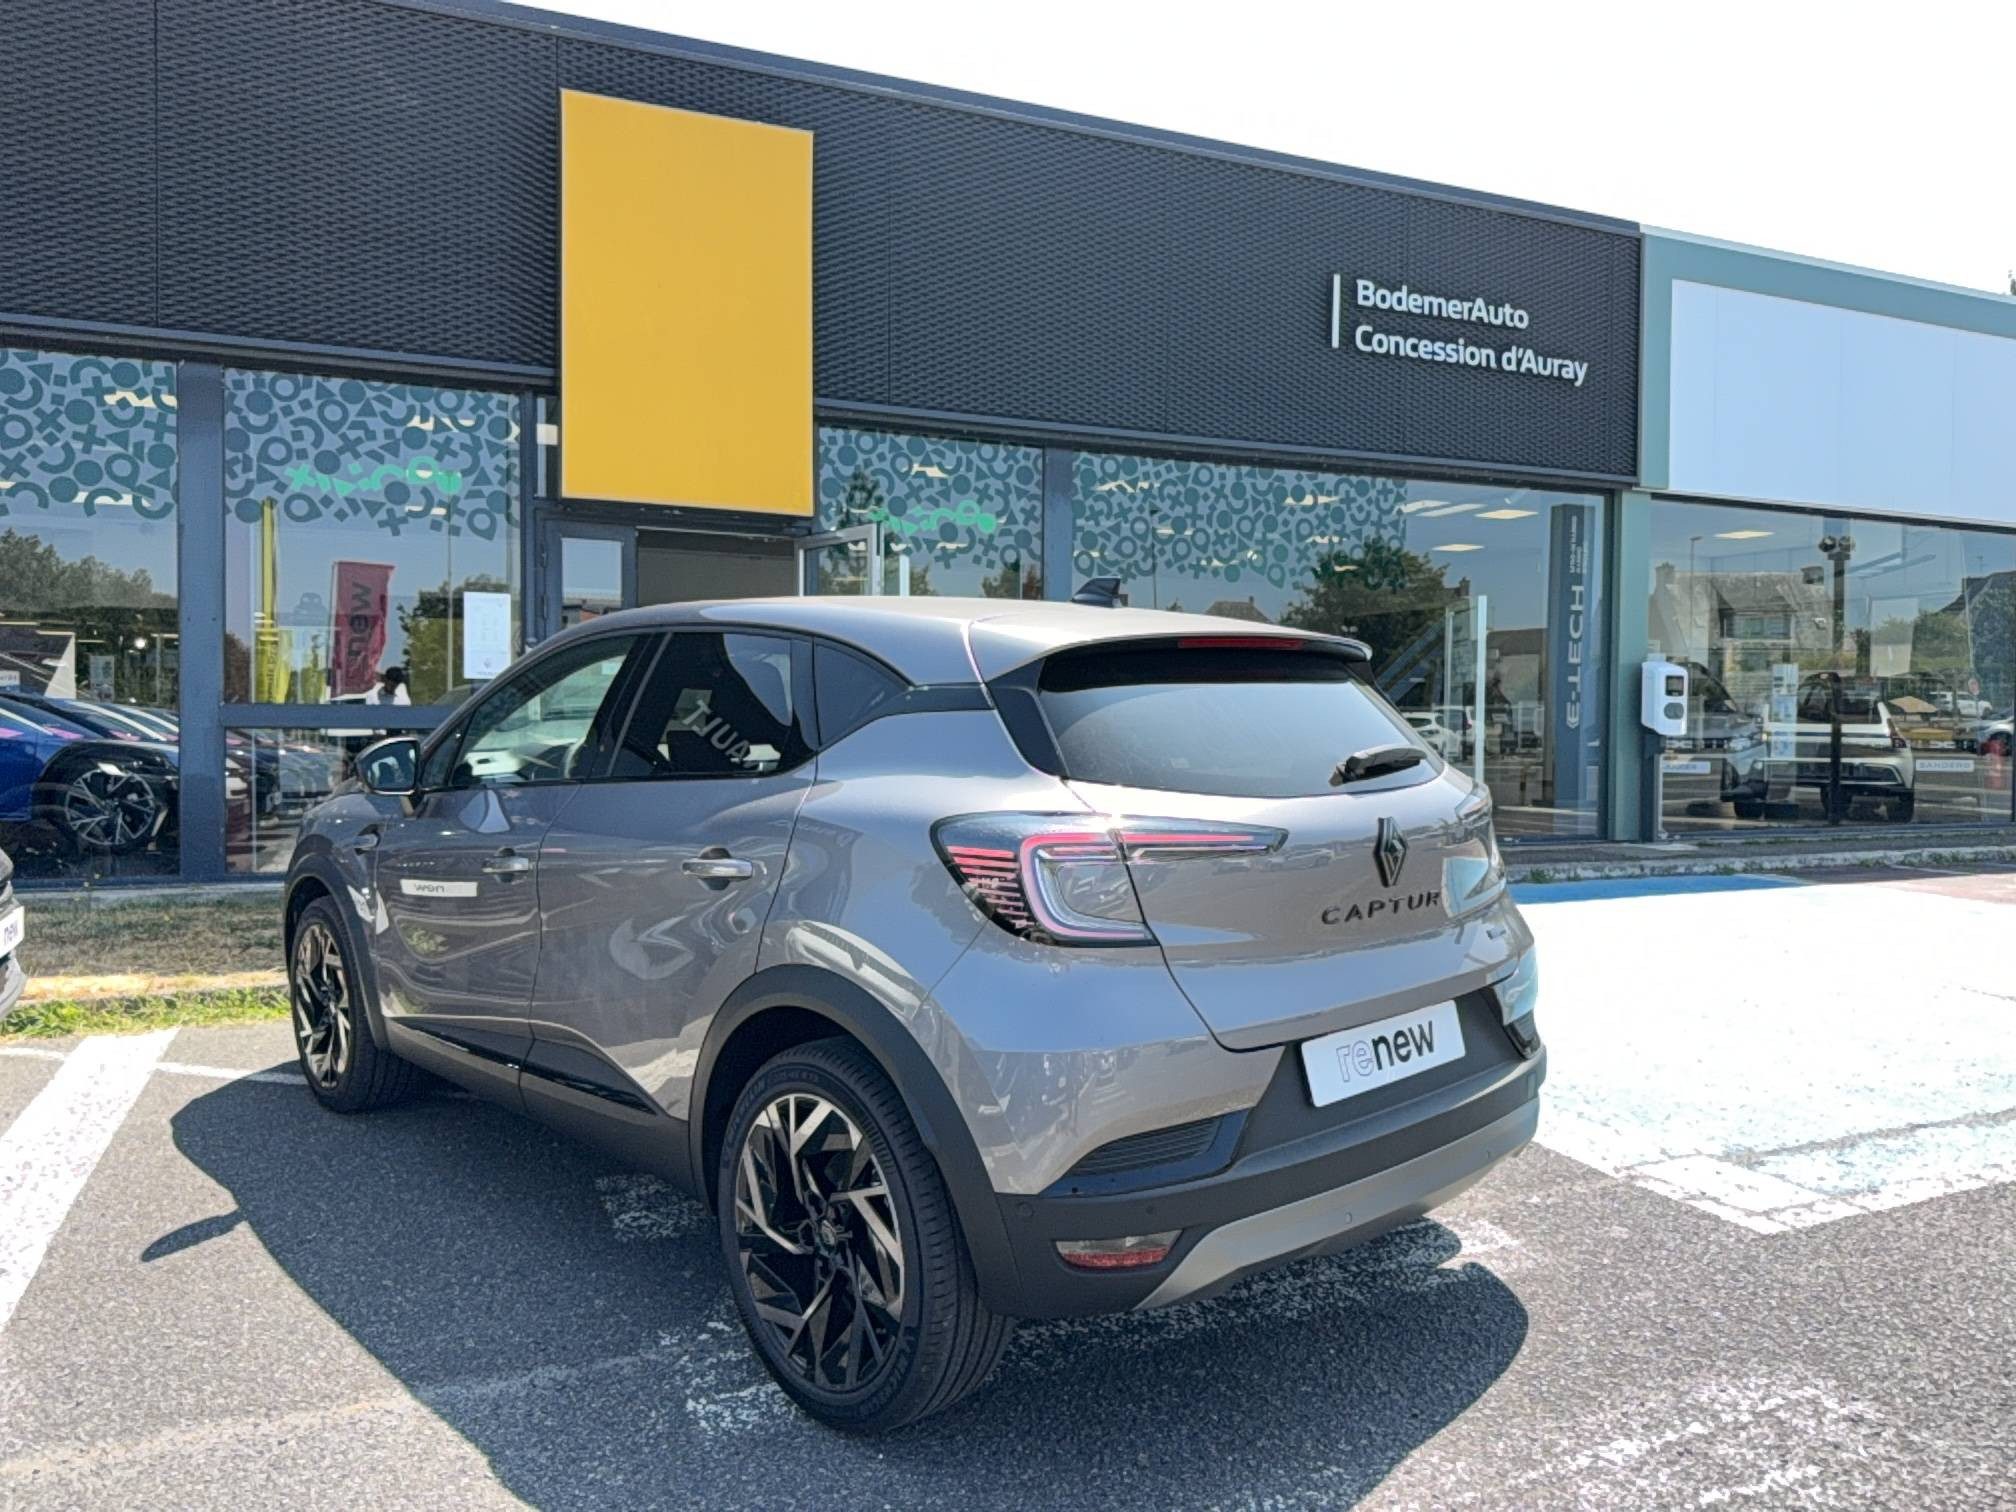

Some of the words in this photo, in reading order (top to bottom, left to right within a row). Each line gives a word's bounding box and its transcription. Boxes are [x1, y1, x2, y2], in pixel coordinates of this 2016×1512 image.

[1356, 278, 1529, 329] BodemerAuto
[1354, 325, 1497, 369] Concession
[1501, 345, 1589, 387] d'Auray
[1321, 890, 1441, 925] CAPTUR
[1336, 1020, 1434, 1083] renew
